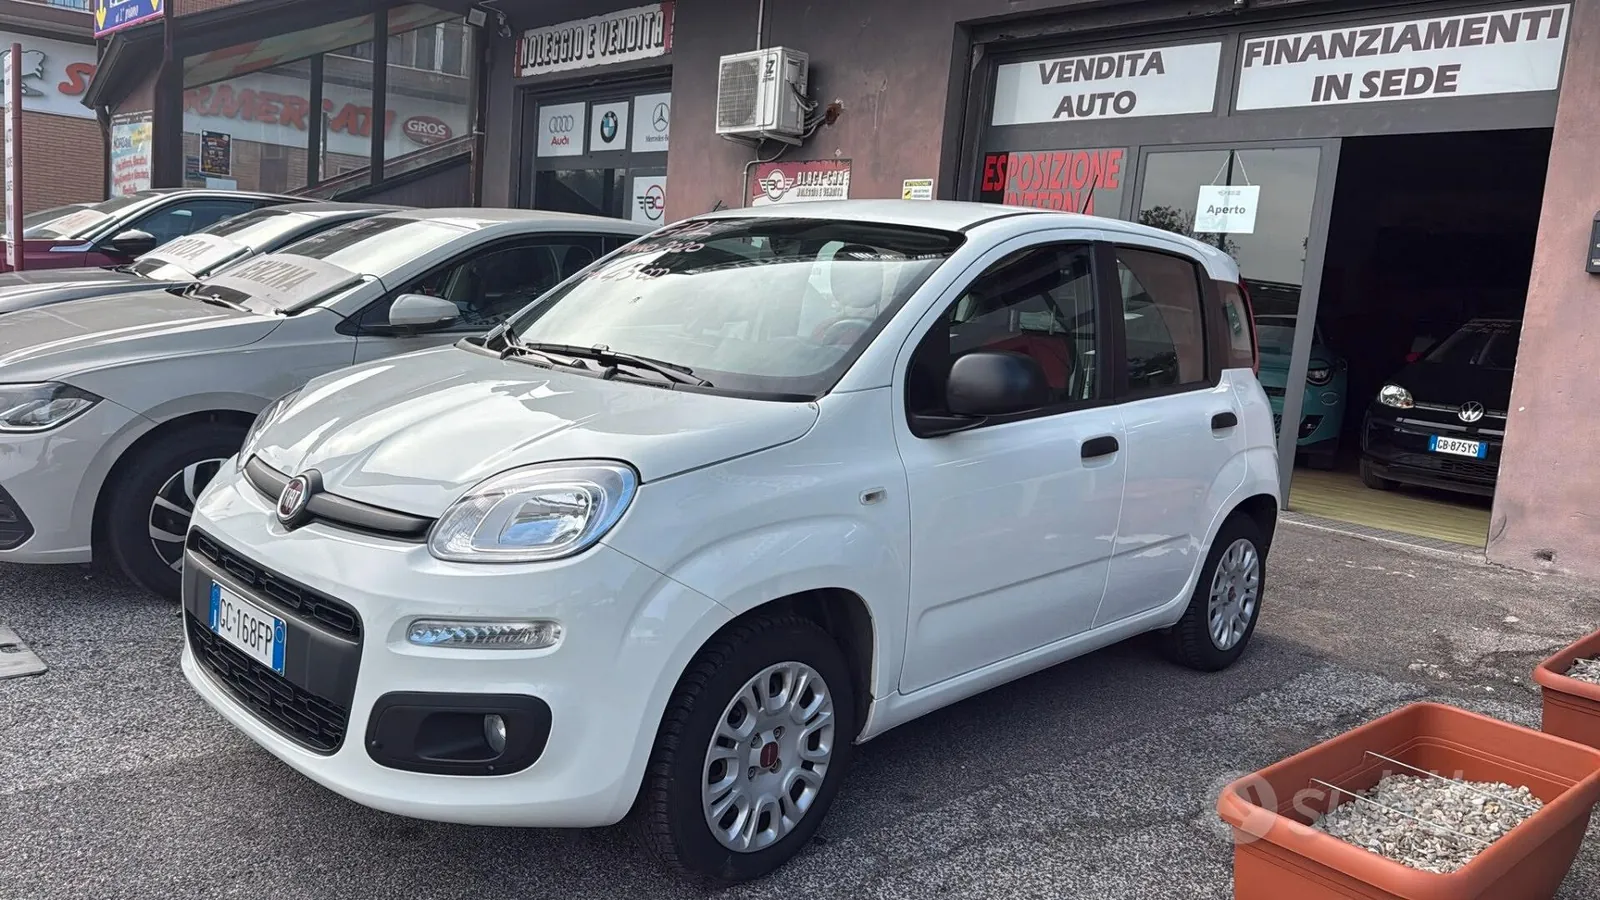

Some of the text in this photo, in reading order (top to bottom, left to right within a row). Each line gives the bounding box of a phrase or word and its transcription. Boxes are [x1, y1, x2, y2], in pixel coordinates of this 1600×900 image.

[520, 11, 665, 68] NOLEGGIO E VENDITA
[1243, 8, 1565, 68] FINANZIAMENTI
[1038, 51, 1165, 85] VENDITA
[1310, 63, 1462, 103] IN SEDE
[1052, 90, 1137, 119] AUTO
[408, 120, 446, 136] GROS
[551, 135, 570, 146] Audi
[981, 150, 1124, 192] ESPOSIZIONE
[1207, 204, 1246, 216] Aperto
